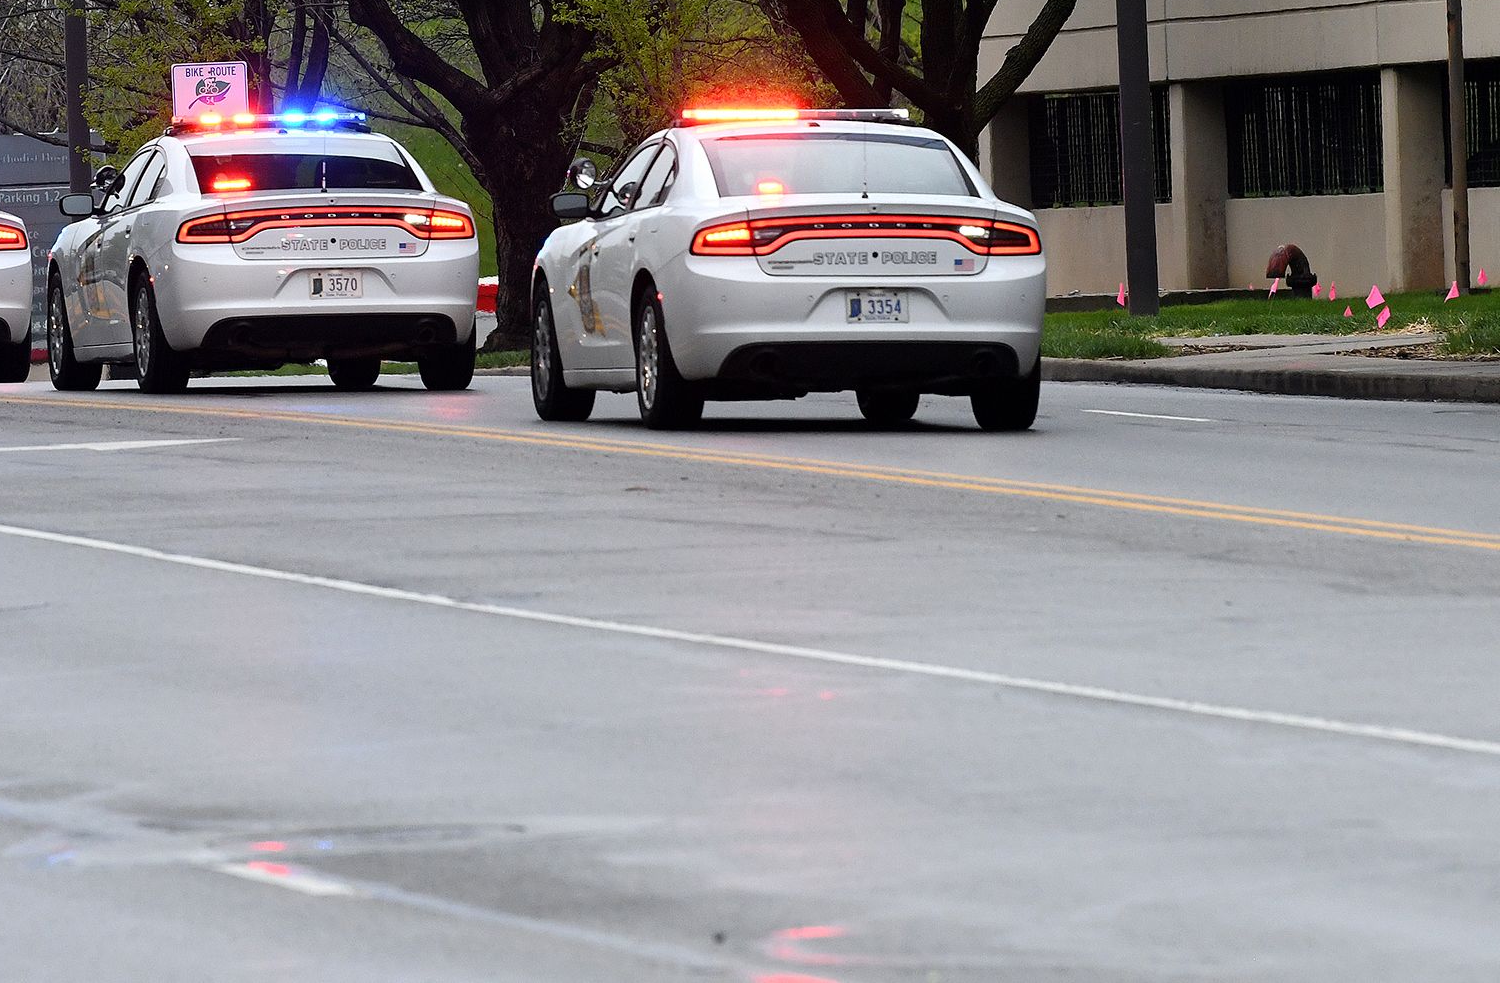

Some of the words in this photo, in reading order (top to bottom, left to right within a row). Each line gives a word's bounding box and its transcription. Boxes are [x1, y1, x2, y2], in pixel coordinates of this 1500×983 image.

[185, 67, 204, 77] BIKE
[210, 66, 236, 77] ROUTE
[281, 238, 329, 251] STATE
[339, 238, 387, 250] POLICE
[812, 251, 868, 266] STATE
[881, 251, 937, 265] POLICE
[329, 278, 357, 291] 3570
[867, 299, 902, 315] 3354
